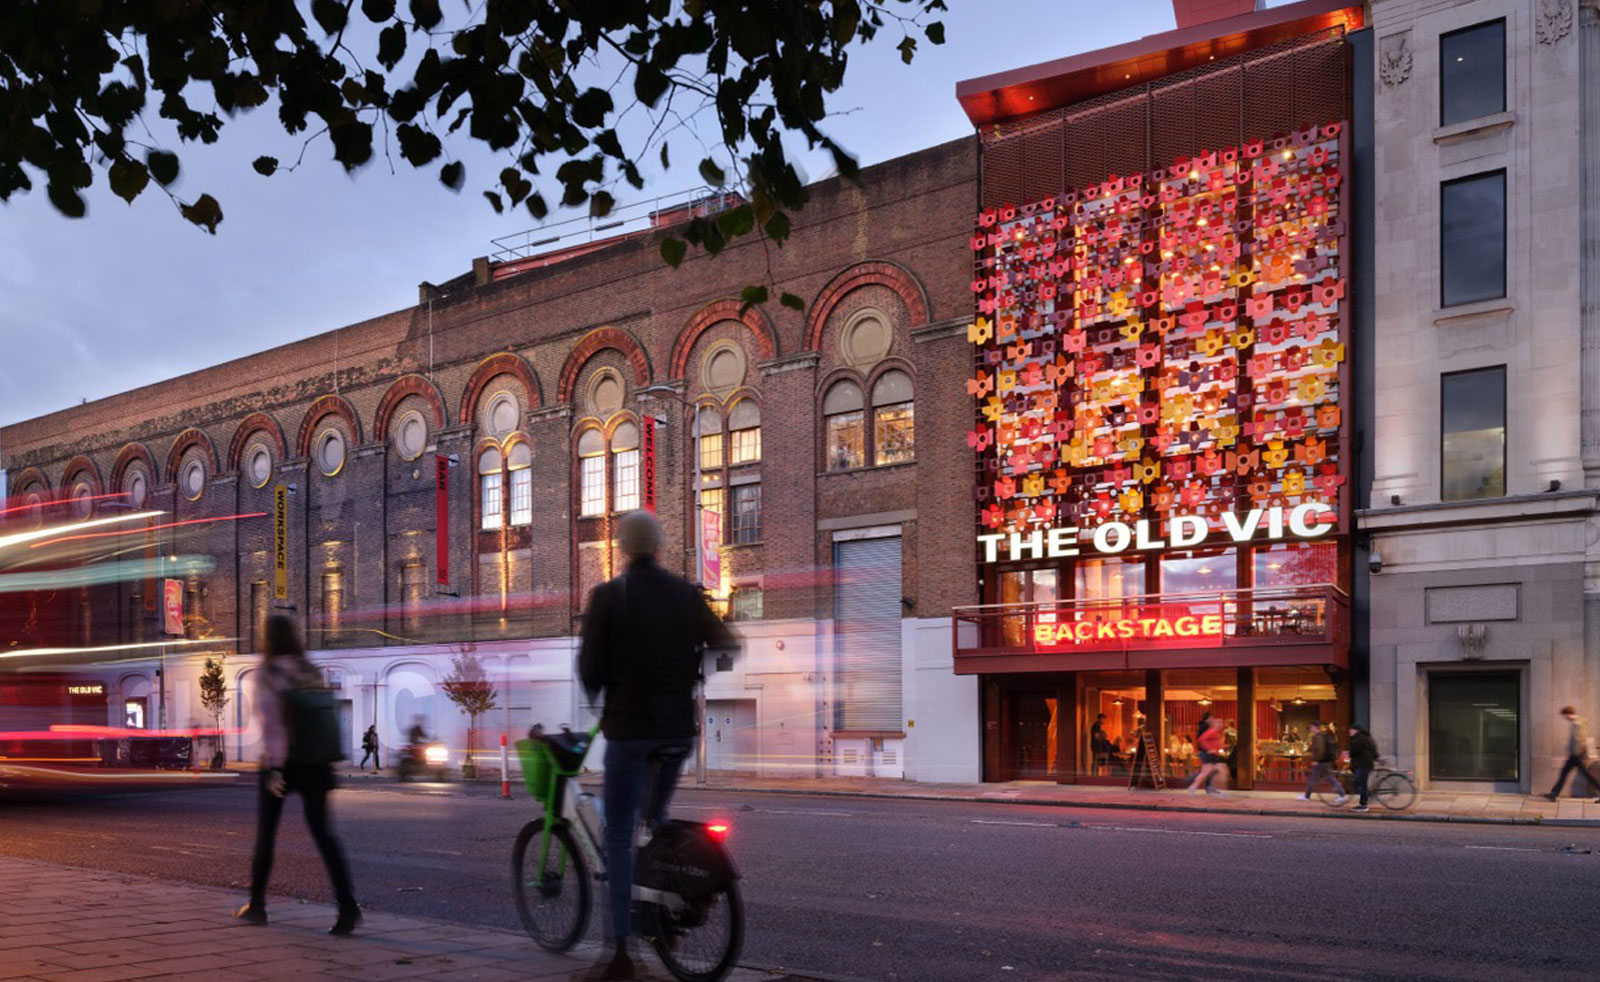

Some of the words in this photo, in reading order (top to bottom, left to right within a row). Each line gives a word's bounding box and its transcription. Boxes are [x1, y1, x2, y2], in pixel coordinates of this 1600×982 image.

[645, 422, 653, 506] WELCOME
[277, 490, 285, 569] WORKSPACE
[977, 527, 1080, 563] THE
[1093, 515, 1208, 553] OLD
[1220, 502, 1333, 542] VIC
[1035, 616, 1222, 641] BACKSTAGE
[68, 686, 79, 694] THE
[80, 686, 91, 694] OLD
[91, 686, 103, 694] VIC
